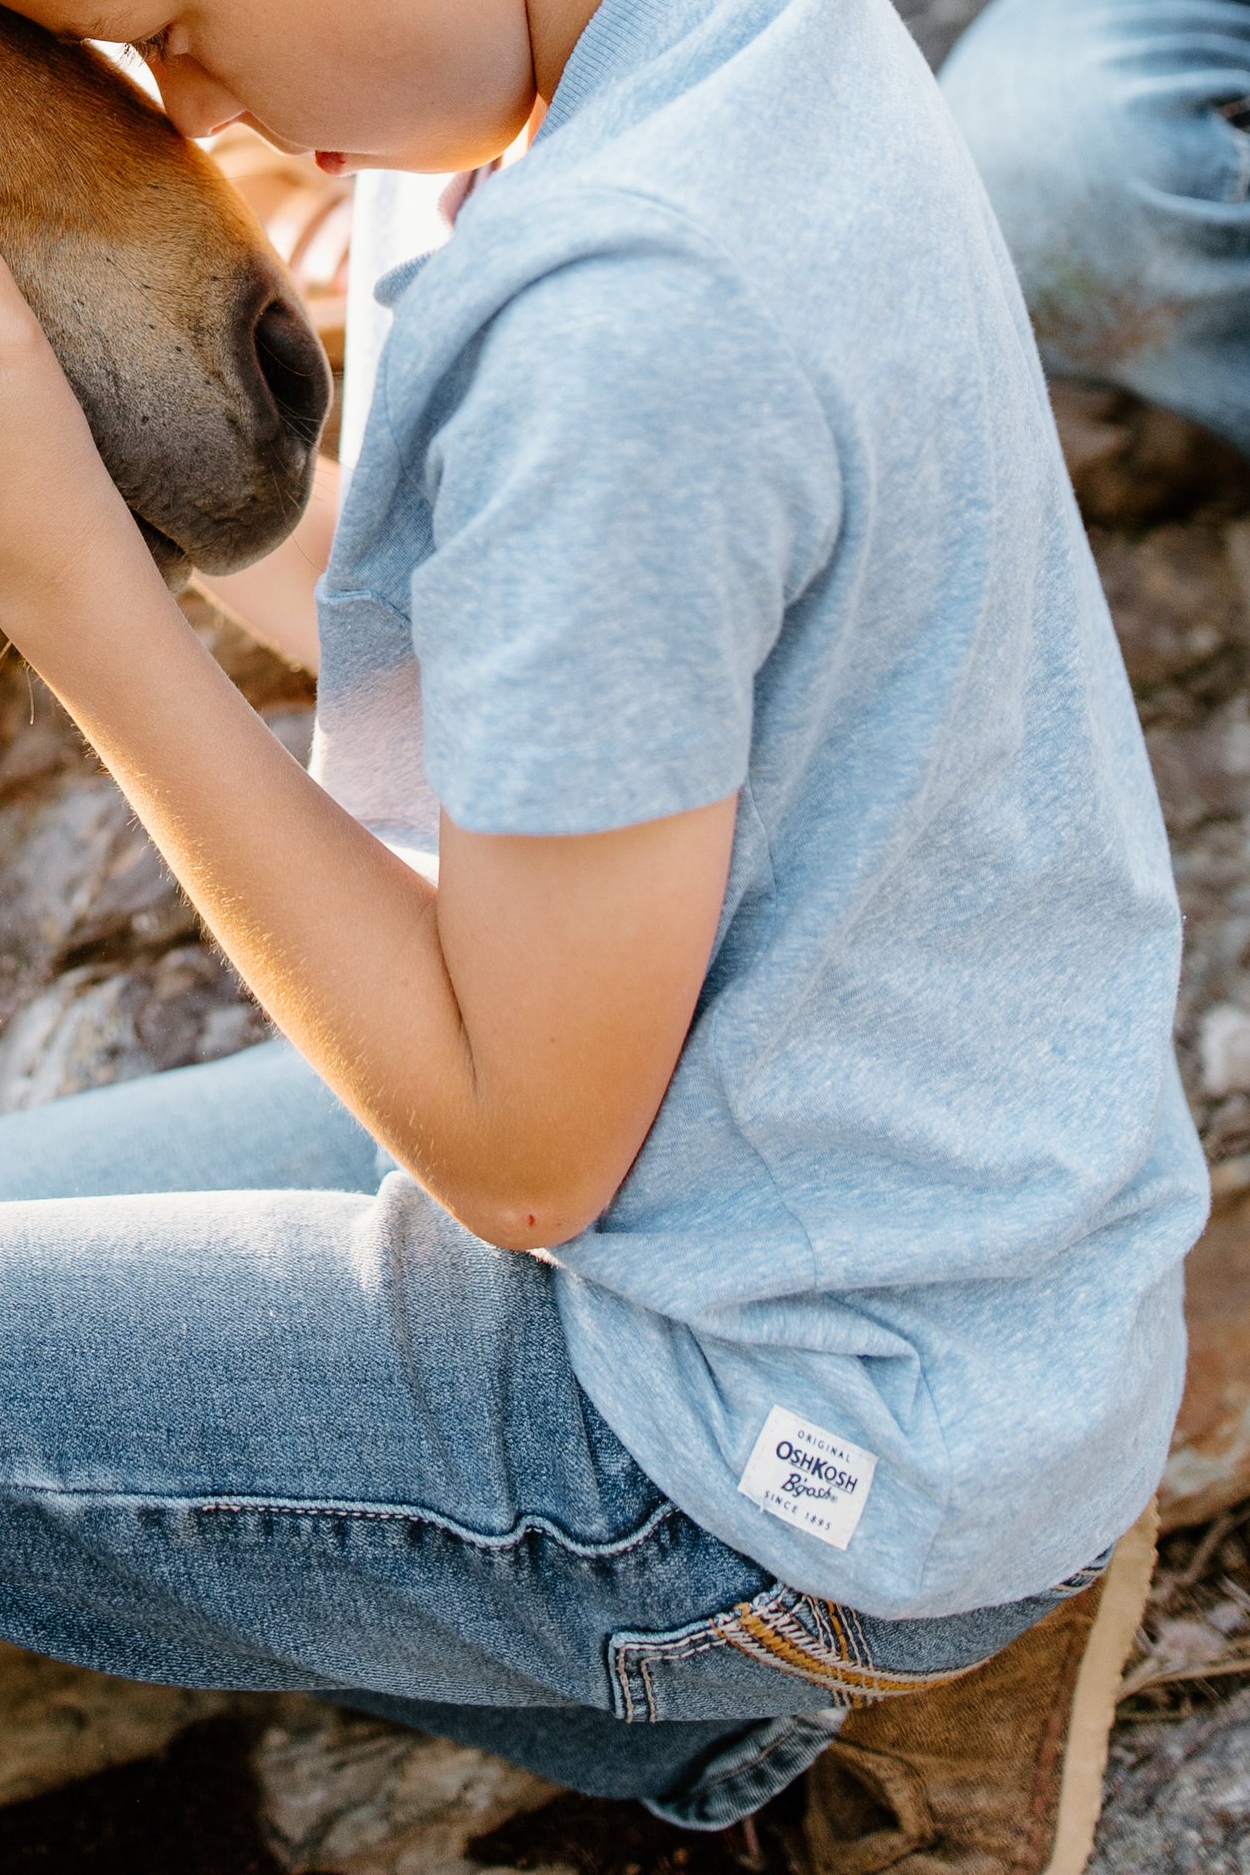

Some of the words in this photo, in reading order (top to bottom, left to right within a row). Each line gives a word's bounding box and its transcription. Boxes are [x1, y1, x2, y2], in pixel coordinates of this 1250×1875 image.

[776, 1441, 858, 1492] OSHKOSH
[797, 1430, 850, 1463] ORIGINAL
[764, 1490, 799, 1514] SINCE
[805, 1512, 832, 1531] 1895
